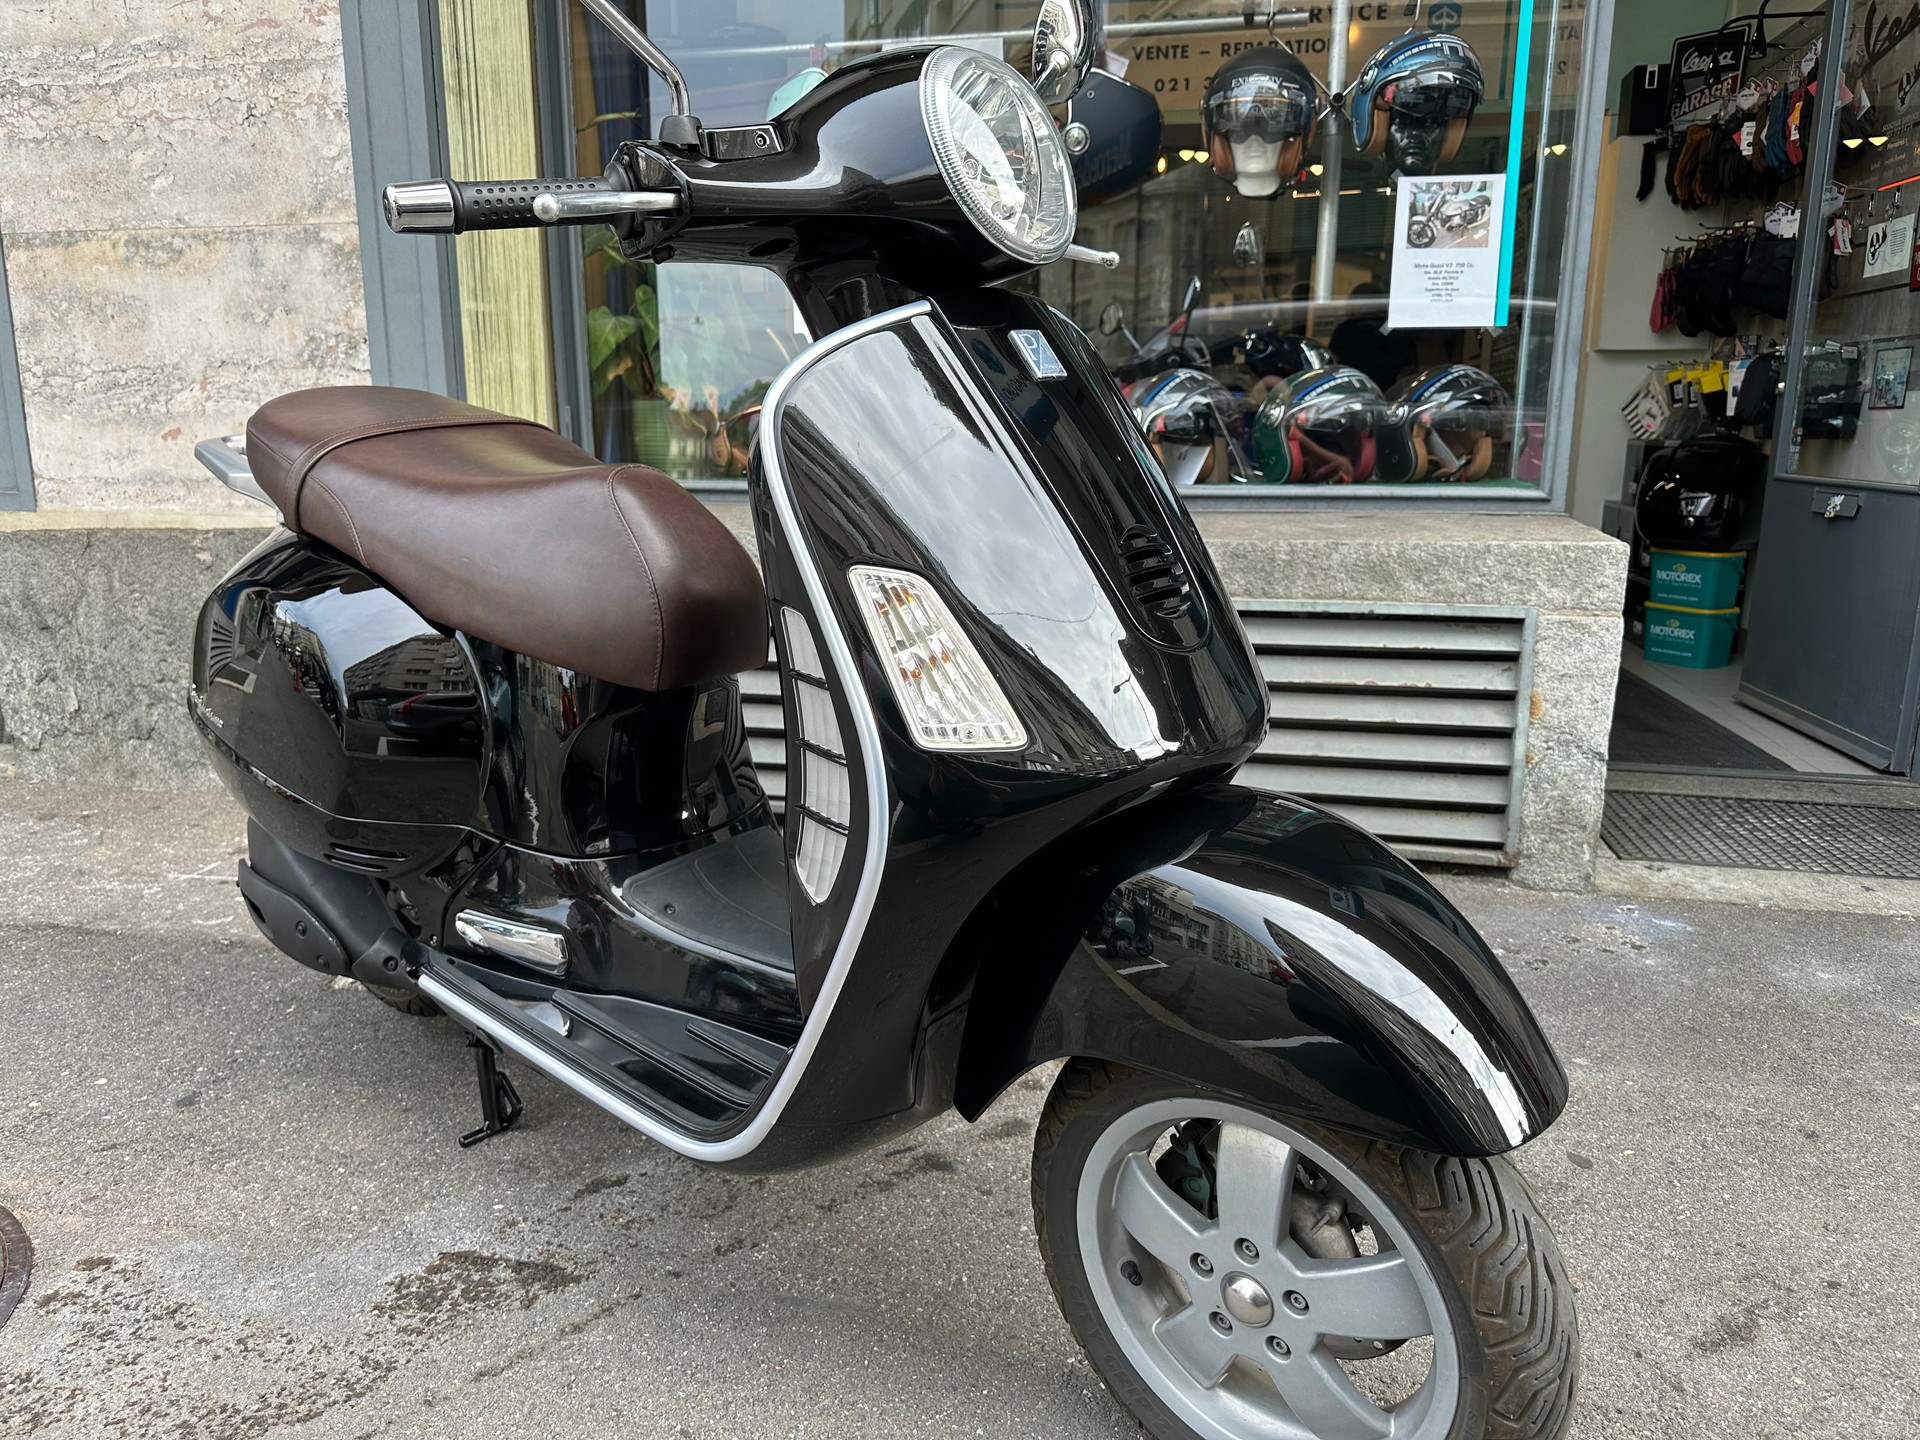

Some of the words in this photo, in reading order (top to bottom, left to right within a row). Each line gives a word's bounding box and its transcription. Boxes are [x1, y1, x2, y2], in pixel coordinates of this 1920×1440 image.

[1132, 44, 1190, 61] VENTE
[1154, 78, 1190, 92] 021
[1656, 570, 1702, 584] MOTOREX
[1650, 625, 1695, 639] MOTOREX
